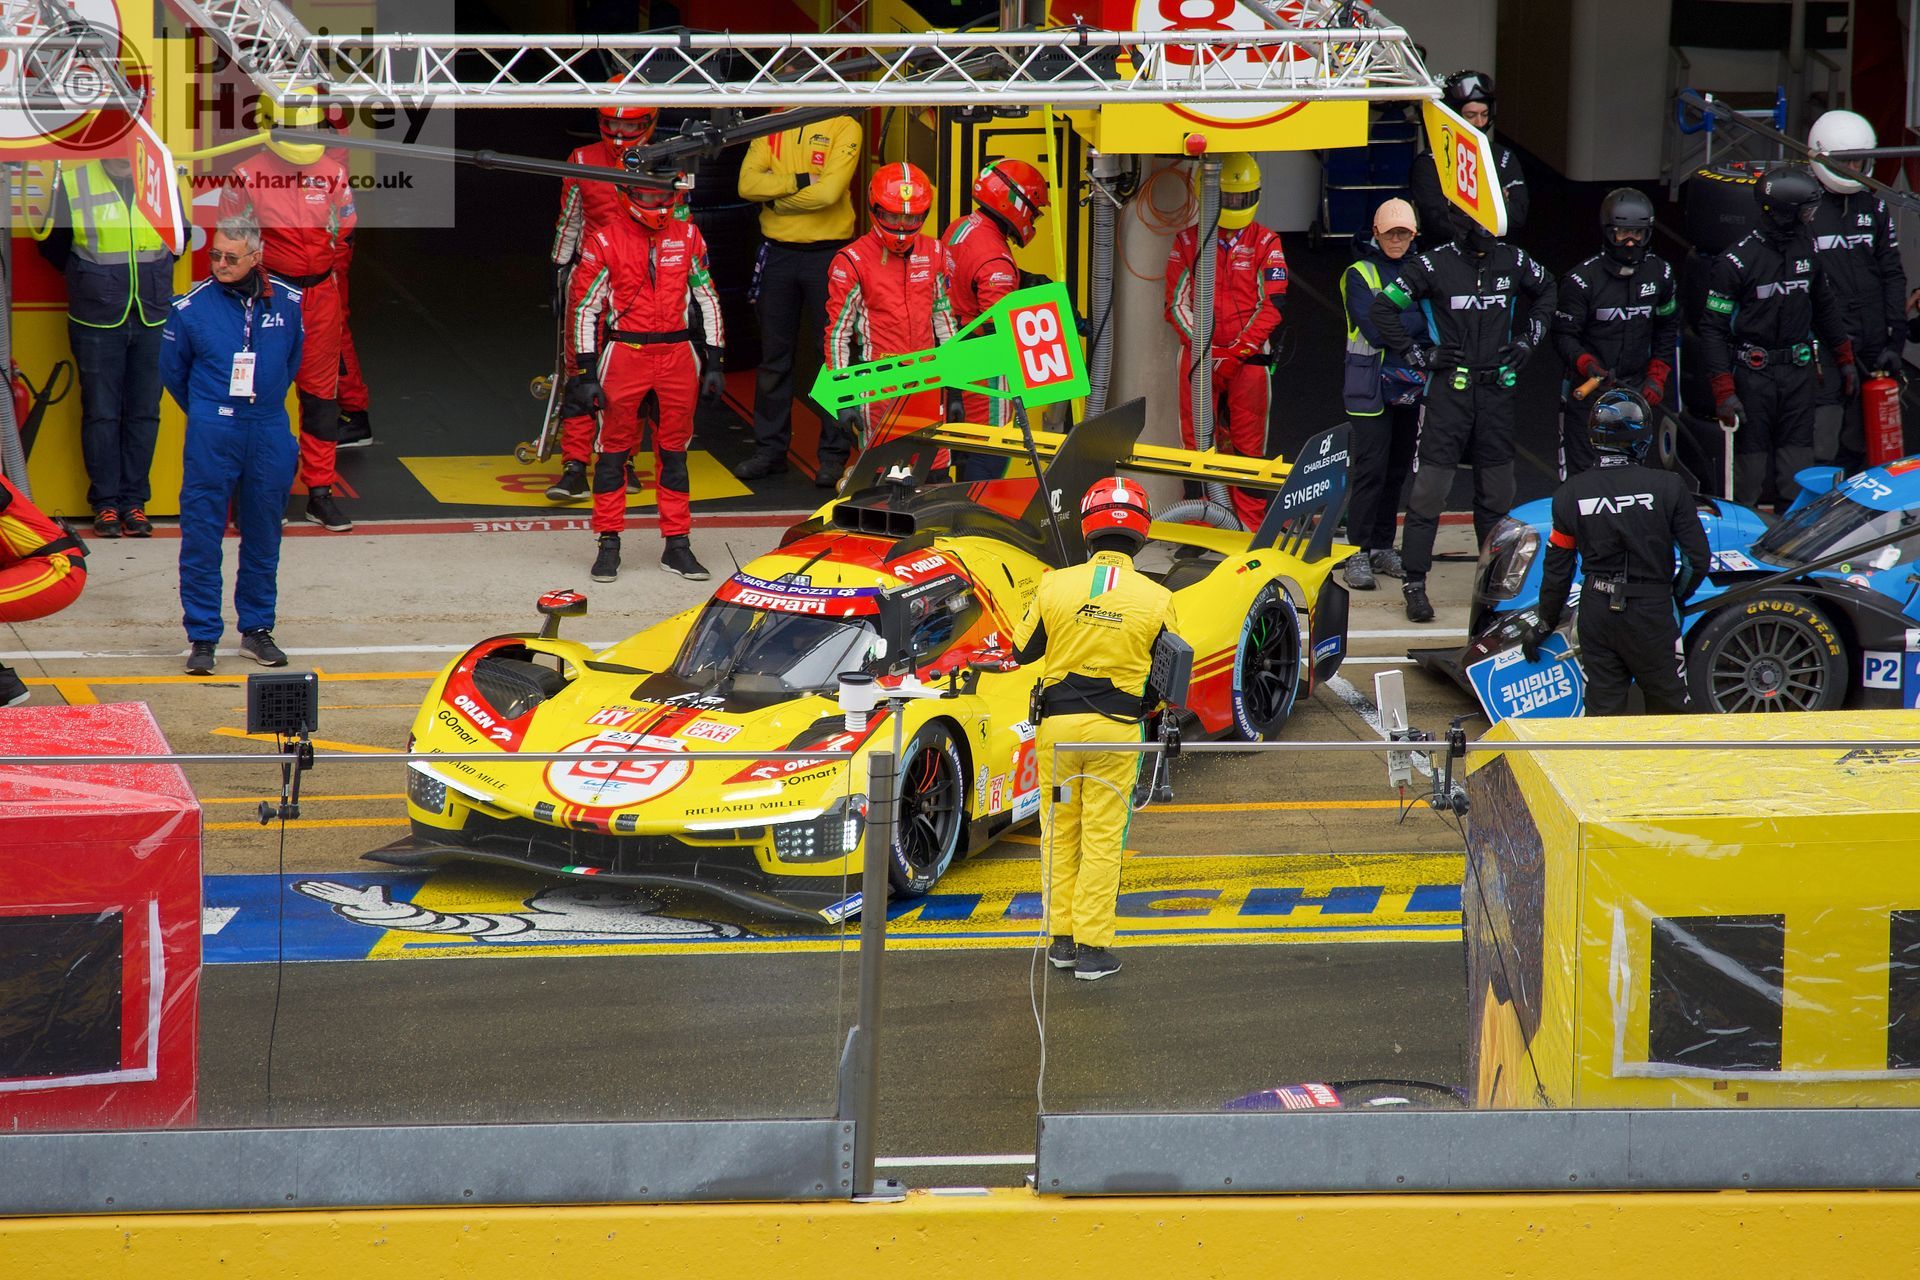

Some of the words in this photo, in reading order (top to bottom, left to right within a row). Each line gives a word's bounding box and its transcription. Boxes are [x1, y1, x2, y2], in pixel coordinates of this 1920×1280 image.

[1457, 142, 1478, 200] 83
[146, 155, 162, 219] 51
[1832, 234, 1874, 250] APR
[1769, 279, 1810, 296] APR
[1462, 294, 1507, 310] APR
[261, 312, 285, 329] 24h
[1607, 306, 1652, 321] APR
[1016, 308, 1069, 383] 83
[1303, 456, 1331, 475] CHARLES
[1594, 493, 1654, 515] APR
[473, 521, 550, 532] LANE
[910, 555, 947, 573] ORLEN
[735, 574, 784, 592] CHARLES
[787, 586, 832, 596] POZZI
[730, 588, 828, 615] Ferrari
[1746, 599, 1841, 657] GOODYEAR
[1865, 657, 1899, 682] P2
[1500, 664, 1565, 703] ENGINE
[1510, 678, 1573, 718] START
[454, 694, 496, 729] ORLEN
[586, 709, 637, 726] HY
[438, 710, 479, 745] GOmart
[686, 727, 732, 743] CAR
[693, 720, 737, 733] HYPER
[684, 802, 755, 817] RICHARD
[760, 799, 806, 810] MILLE
